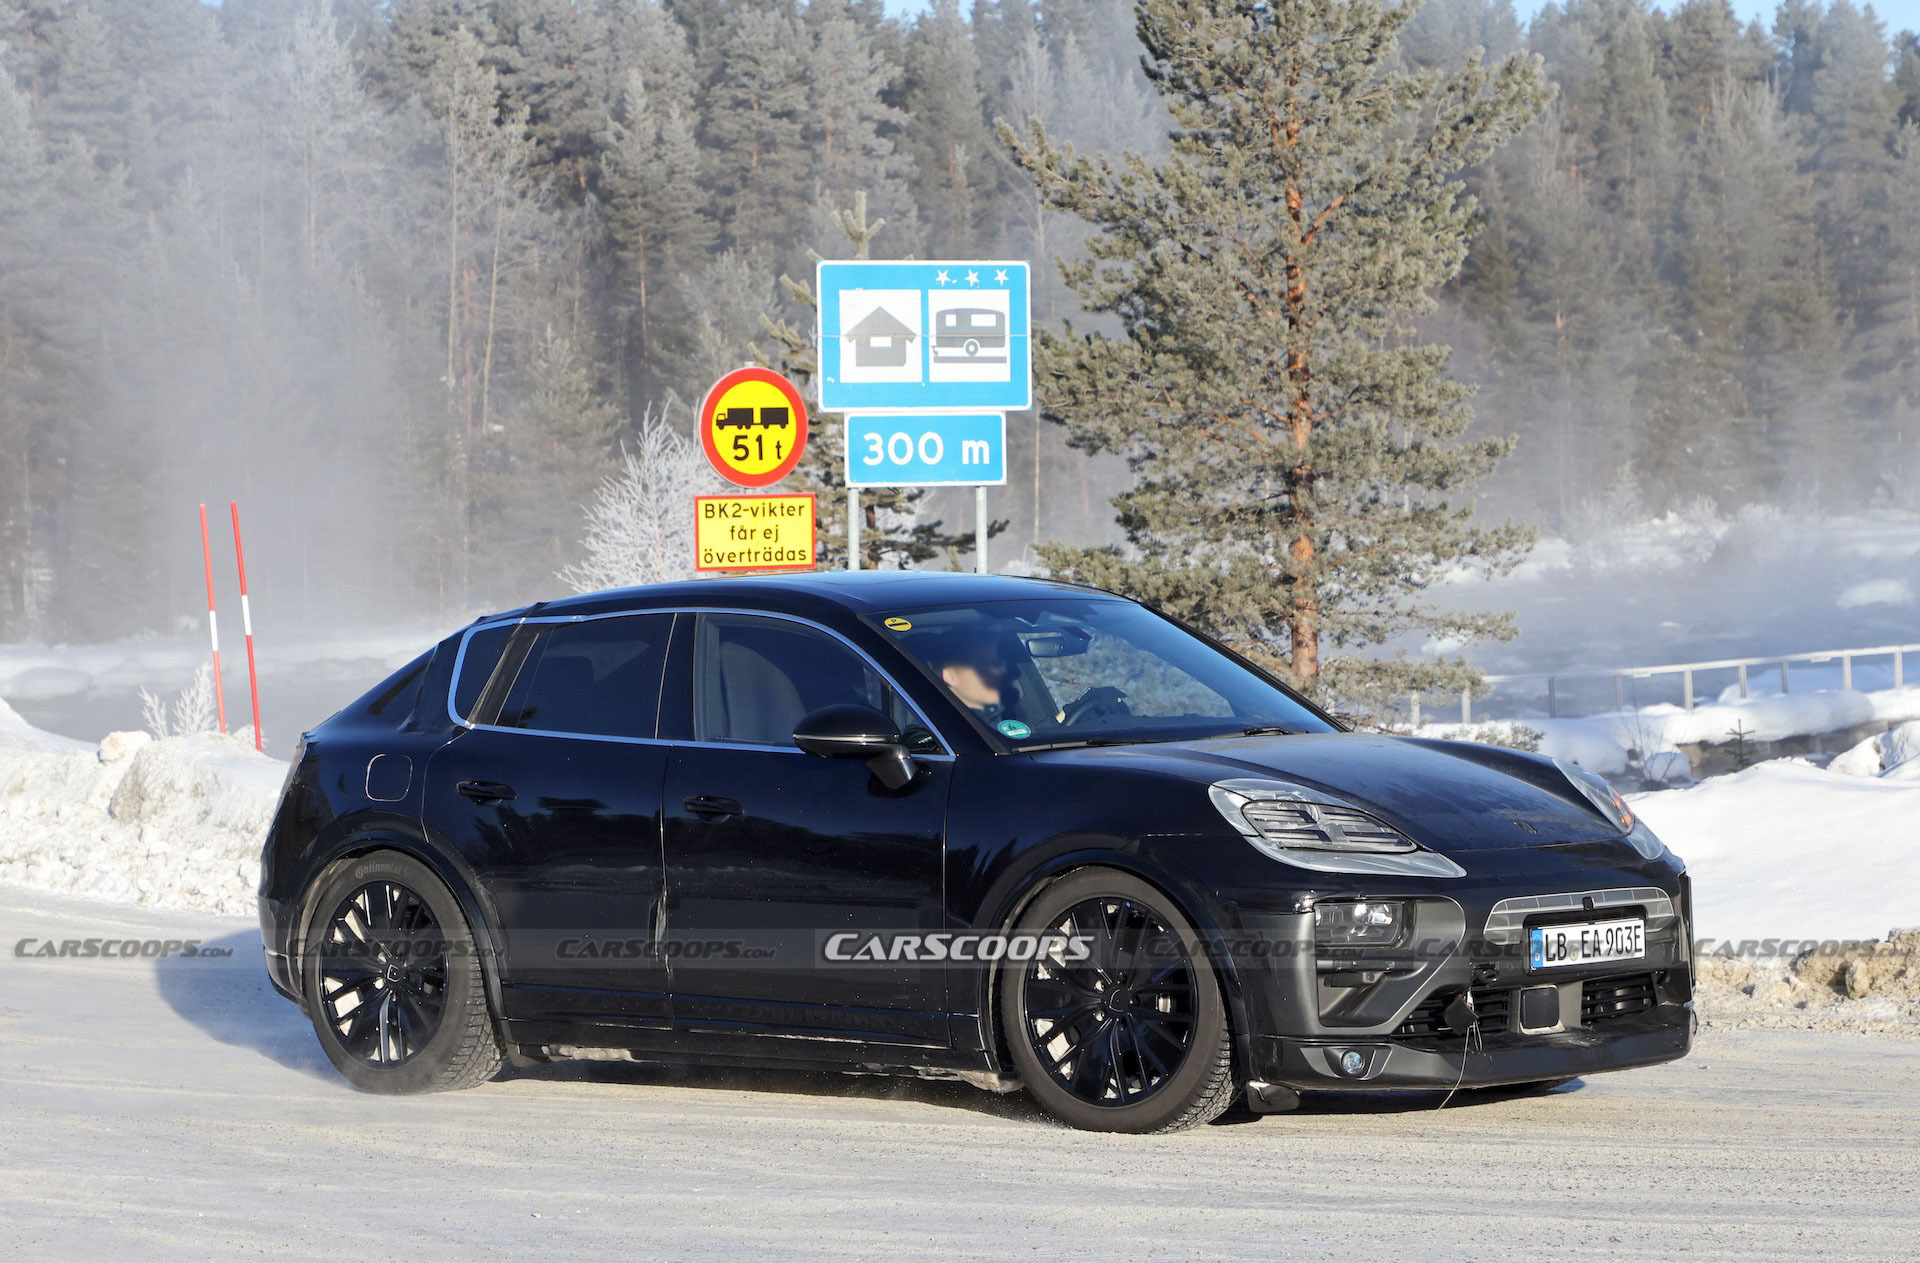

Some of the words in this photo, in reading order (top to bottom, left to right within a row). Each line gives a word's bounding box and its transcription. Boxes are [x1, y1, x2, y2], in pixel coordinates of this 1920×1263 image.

[732, 434, 763, 462] 51
[775, 439, 782, 460] t
[862, 431, 944, 466] 300
[961, 439, 990, 465] m
[704, 502, 805, 519] BK2-vikter
[730, 525, 757, 540] får
[763, 524, 779, 543] ej
[703, 546, 807, 564] överträdas
[1545, 932, 1567, 962] LB
[1581, 929, 1601, 958] EA
[1605, 925, 1643, 956] 903E
